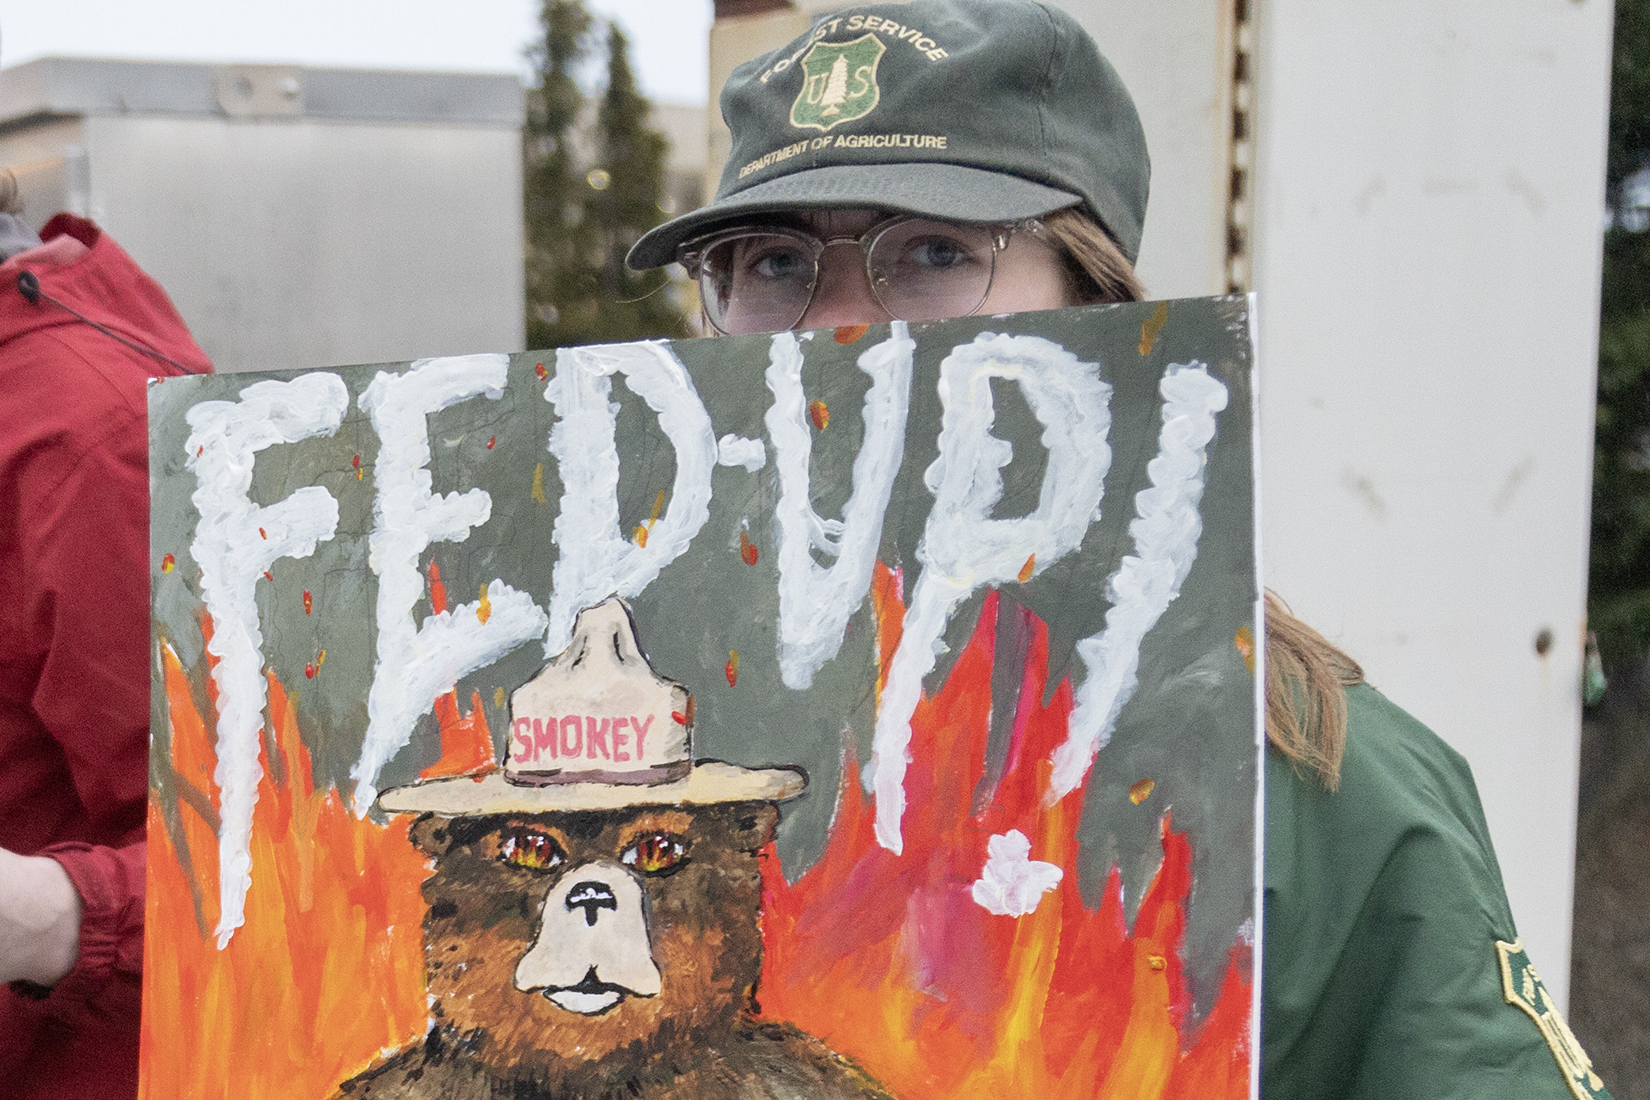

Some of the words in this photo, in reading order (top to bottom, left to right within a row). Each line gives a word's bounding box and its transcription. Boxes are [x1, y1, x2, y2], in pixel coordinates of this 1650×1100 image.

[846, 15, 949, 62] SERVICE
[738, 139, 810, 180] DEPARTMENT
[811, 135, 834, 151] OF
[834, 134, 948, 150] AGRICULTURE
[513, 713, 656, 764] SMOKEY
